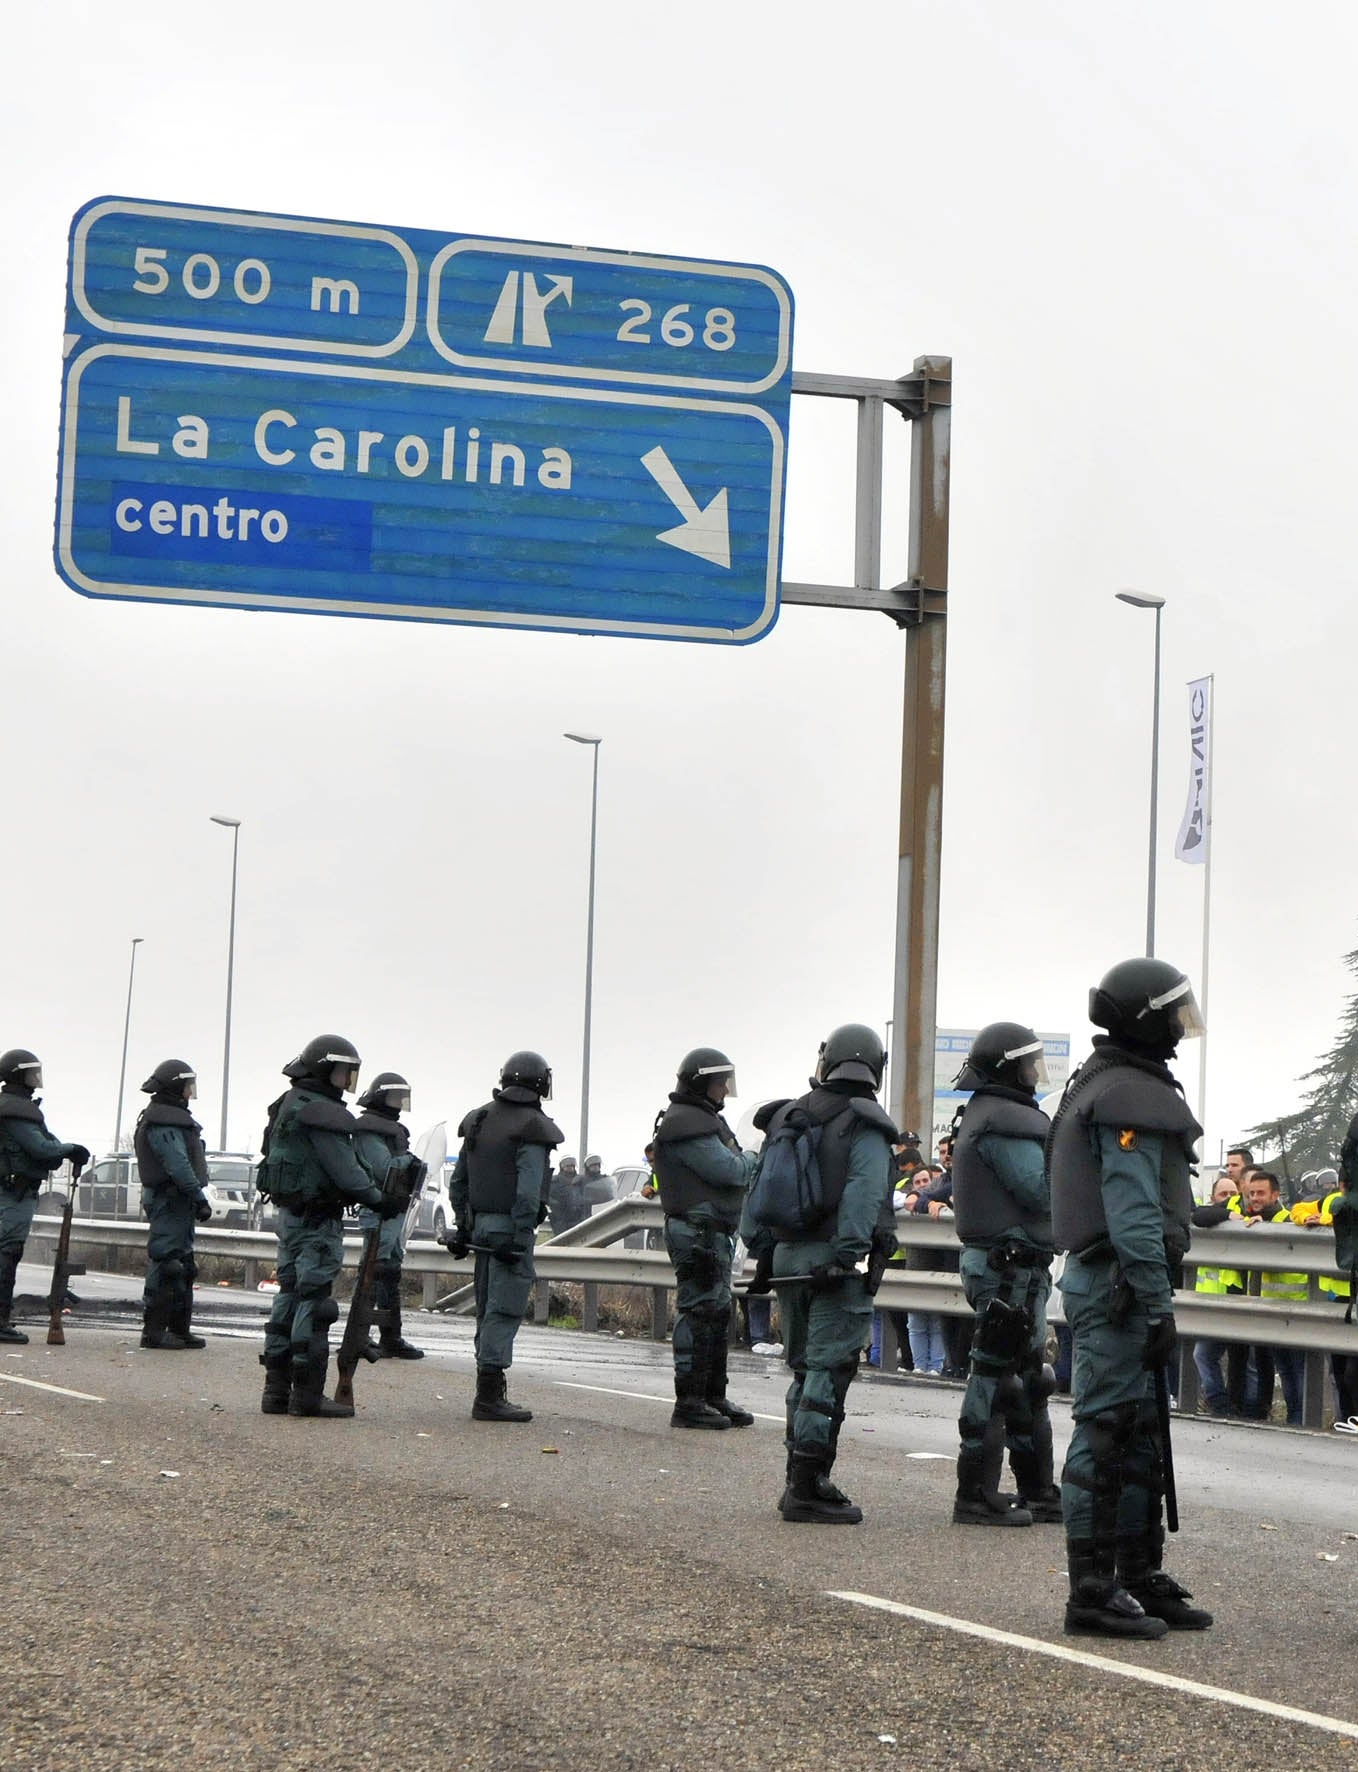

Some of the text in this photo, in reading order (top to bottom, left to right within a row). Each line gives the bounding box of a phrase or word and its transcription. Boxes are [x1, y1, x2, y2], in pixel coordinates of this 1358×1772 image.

[133, 247, 360, 315] 500 m
[616, 298, 737, 351] 268
[116, 396, 572, 490] La Carolina
[116, 497, 288, 543] centro
